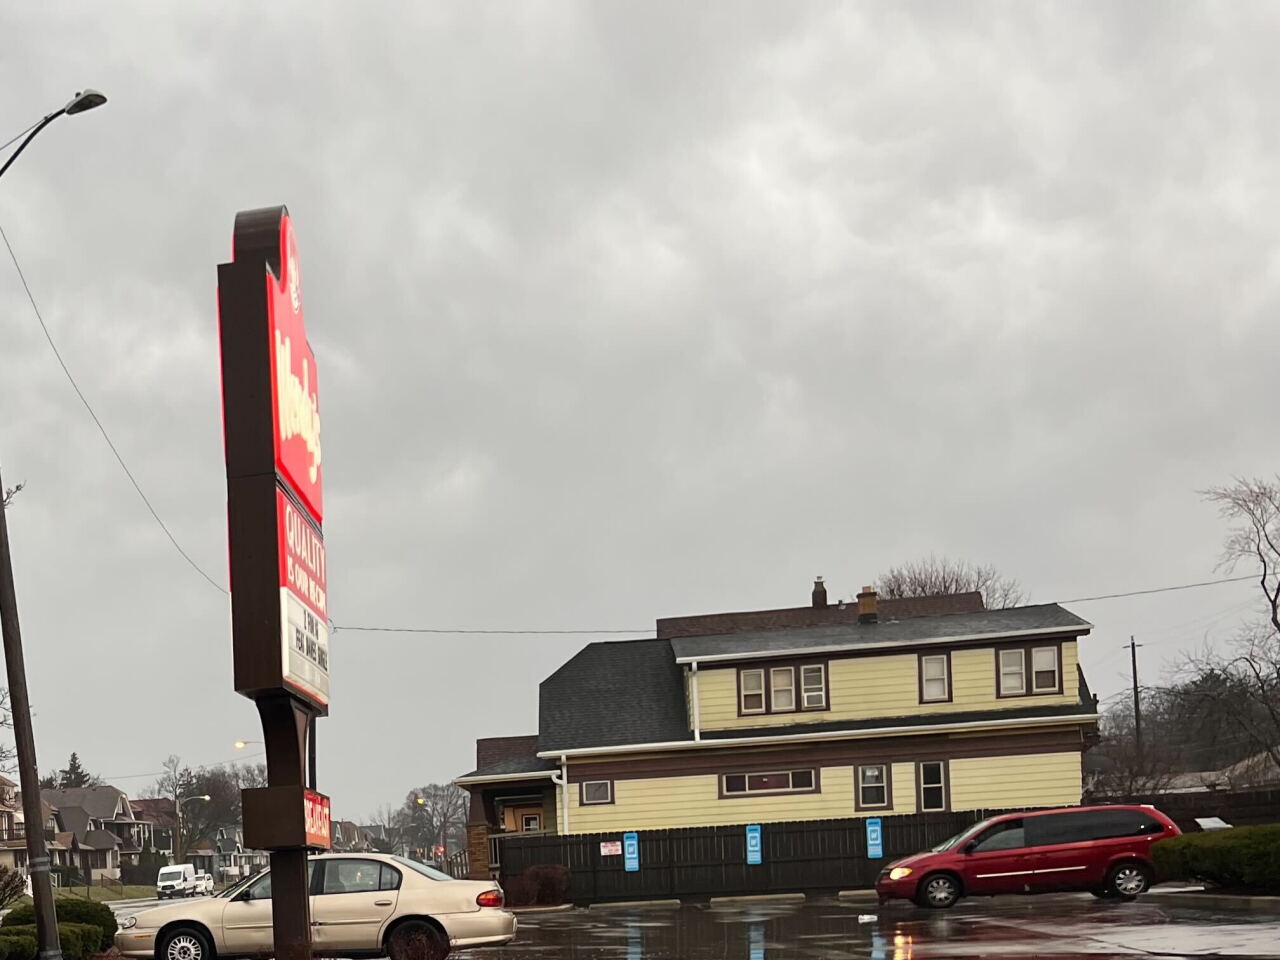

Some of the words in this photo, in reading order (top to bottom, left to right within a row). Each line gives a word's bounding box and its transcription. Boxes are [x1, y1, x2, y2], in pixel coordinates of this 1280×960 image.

[275, 328, 322, 485] Wendy's
[285, 503, 325, 584] QUALITY
[287, 554, 295, 585] IS
[295, 562, 308, 598] OUR
